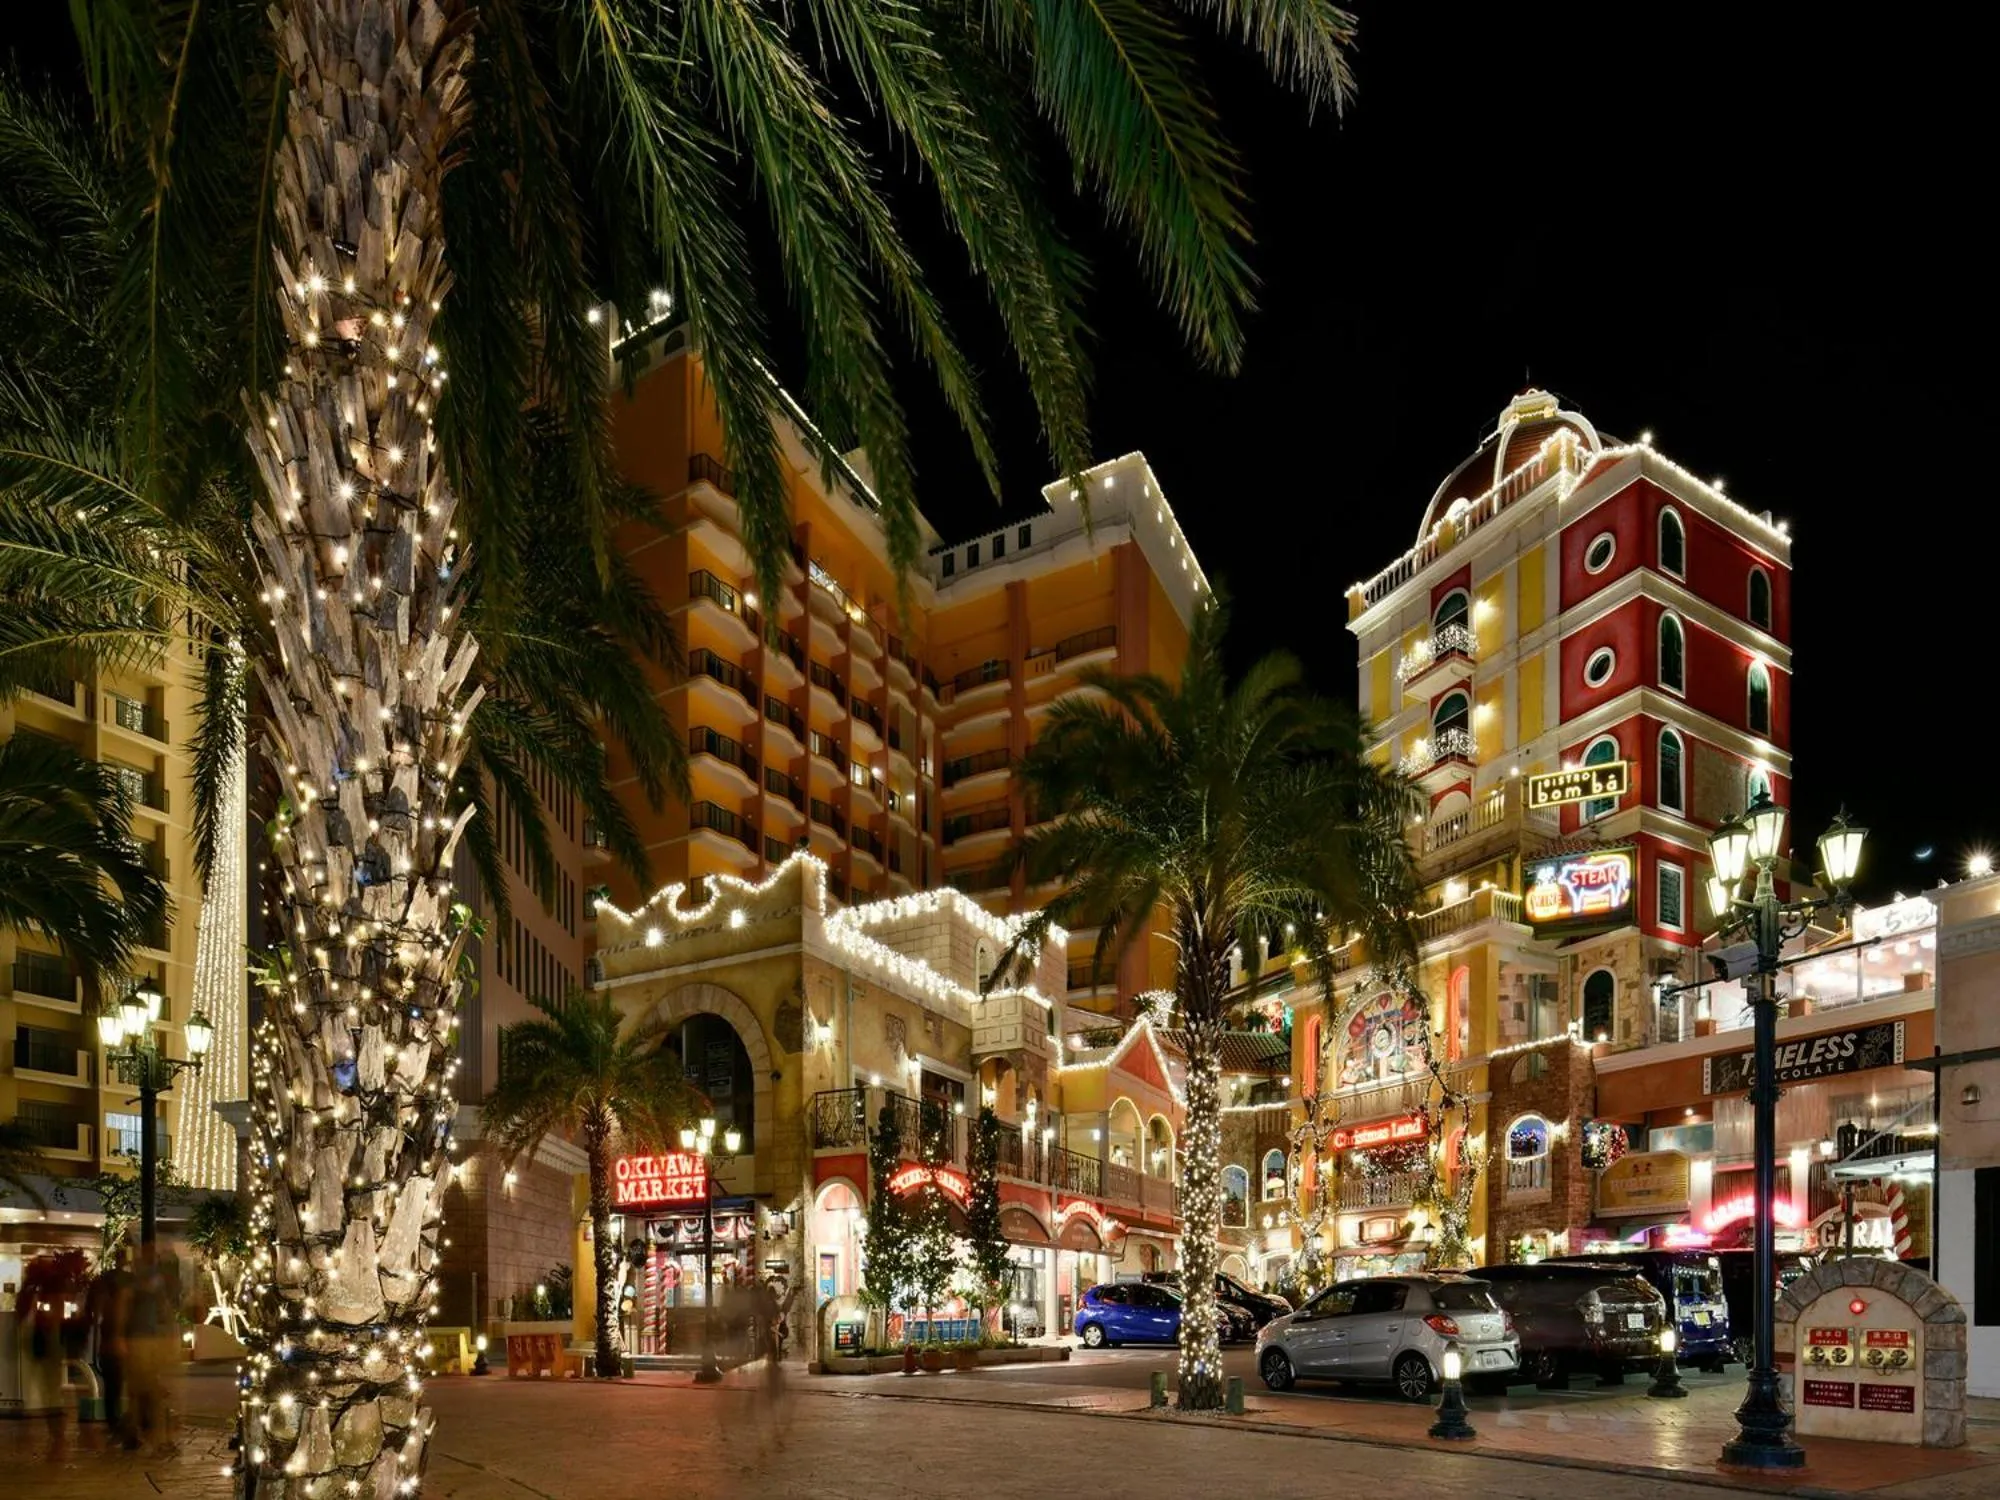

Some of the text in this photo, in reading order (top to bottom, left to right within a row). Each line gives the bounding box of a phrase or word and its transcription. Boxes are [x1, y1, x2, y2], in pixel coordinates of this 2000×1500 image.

[1543, 772, 1590, 788] BISTRO
[1538, 781, 1582, 803] bom
[1571, 866, 1617, 886] STEAK
[1531, 892, 1562, 907] WINE
[1748, 1061, 1845, 1086] CCOLATE
[616, 1153, 705, 1180] OKINAWA
[617, 1175, 706, 1203] MARKET
